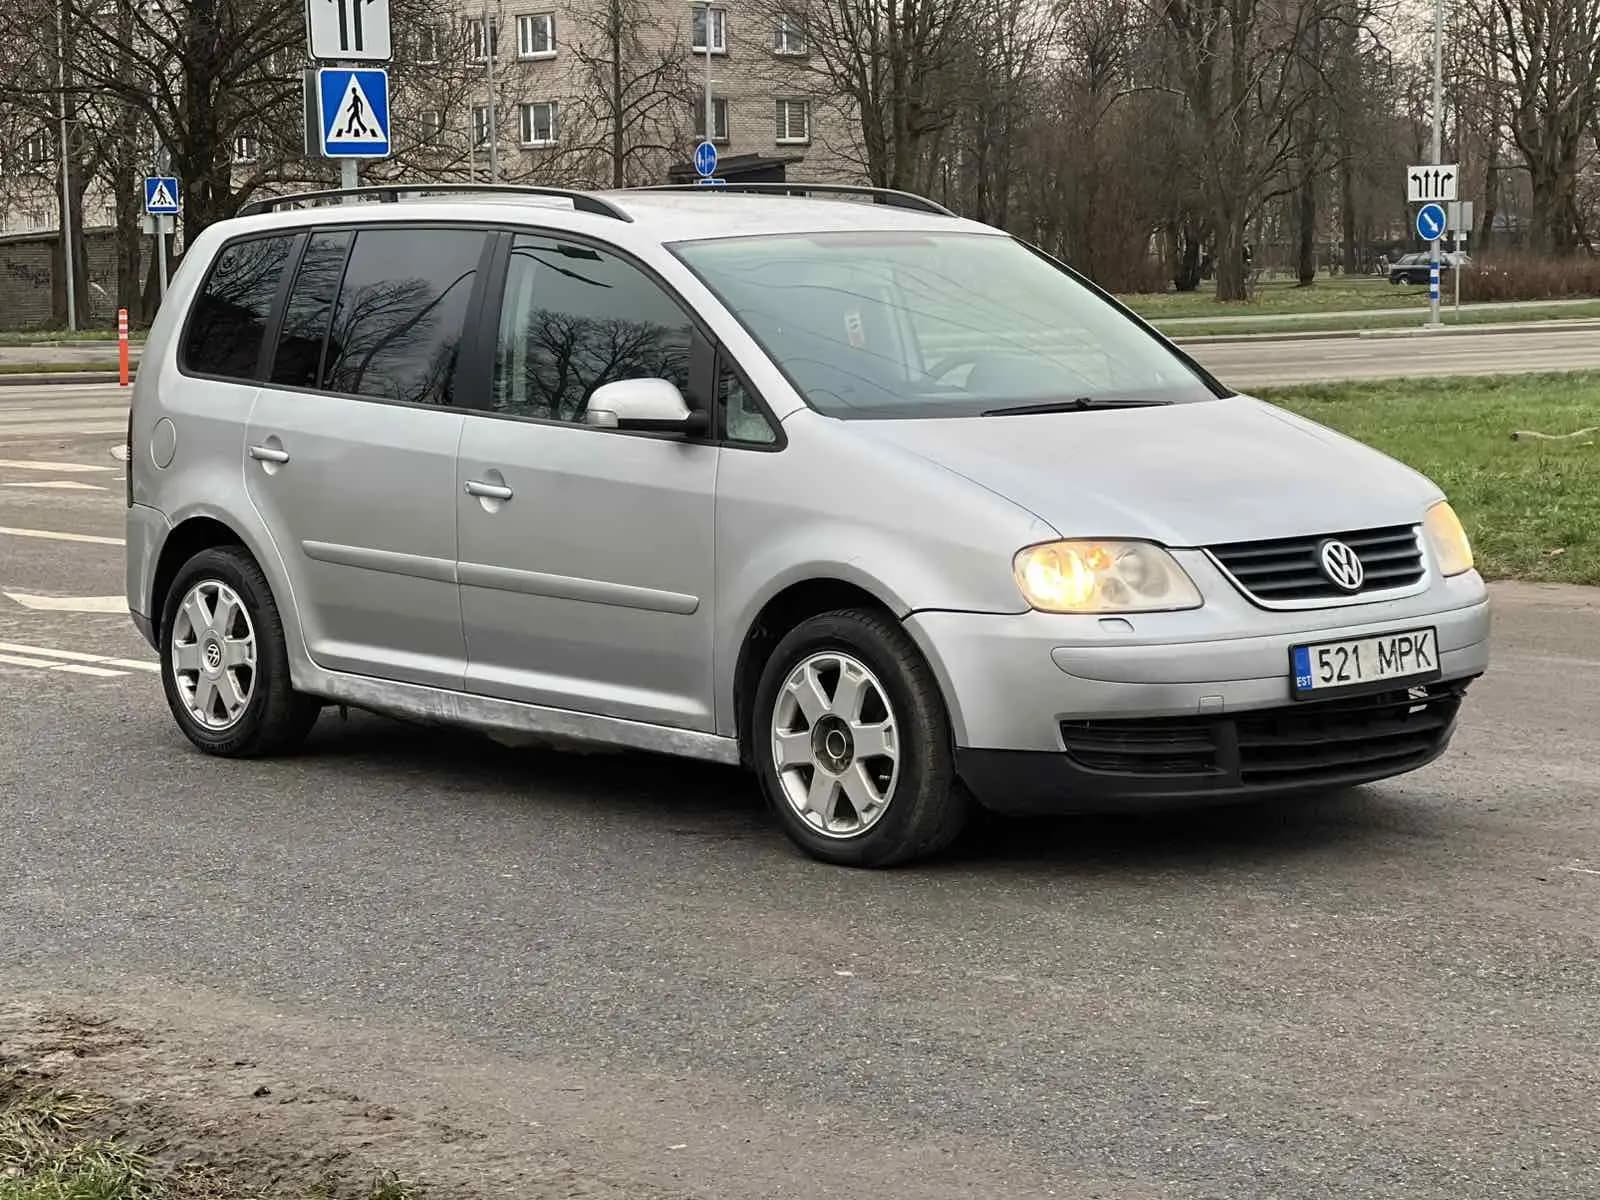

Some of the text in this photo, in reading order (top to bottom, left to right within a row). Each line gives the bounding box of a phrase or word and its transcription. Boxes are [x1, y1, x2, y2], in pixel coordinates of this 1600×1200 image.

[1322, 541, 1363, 589] VW
[1296, 675, 1312, 687] EST
[1318, 633, 1431, 683] 521 MPK
